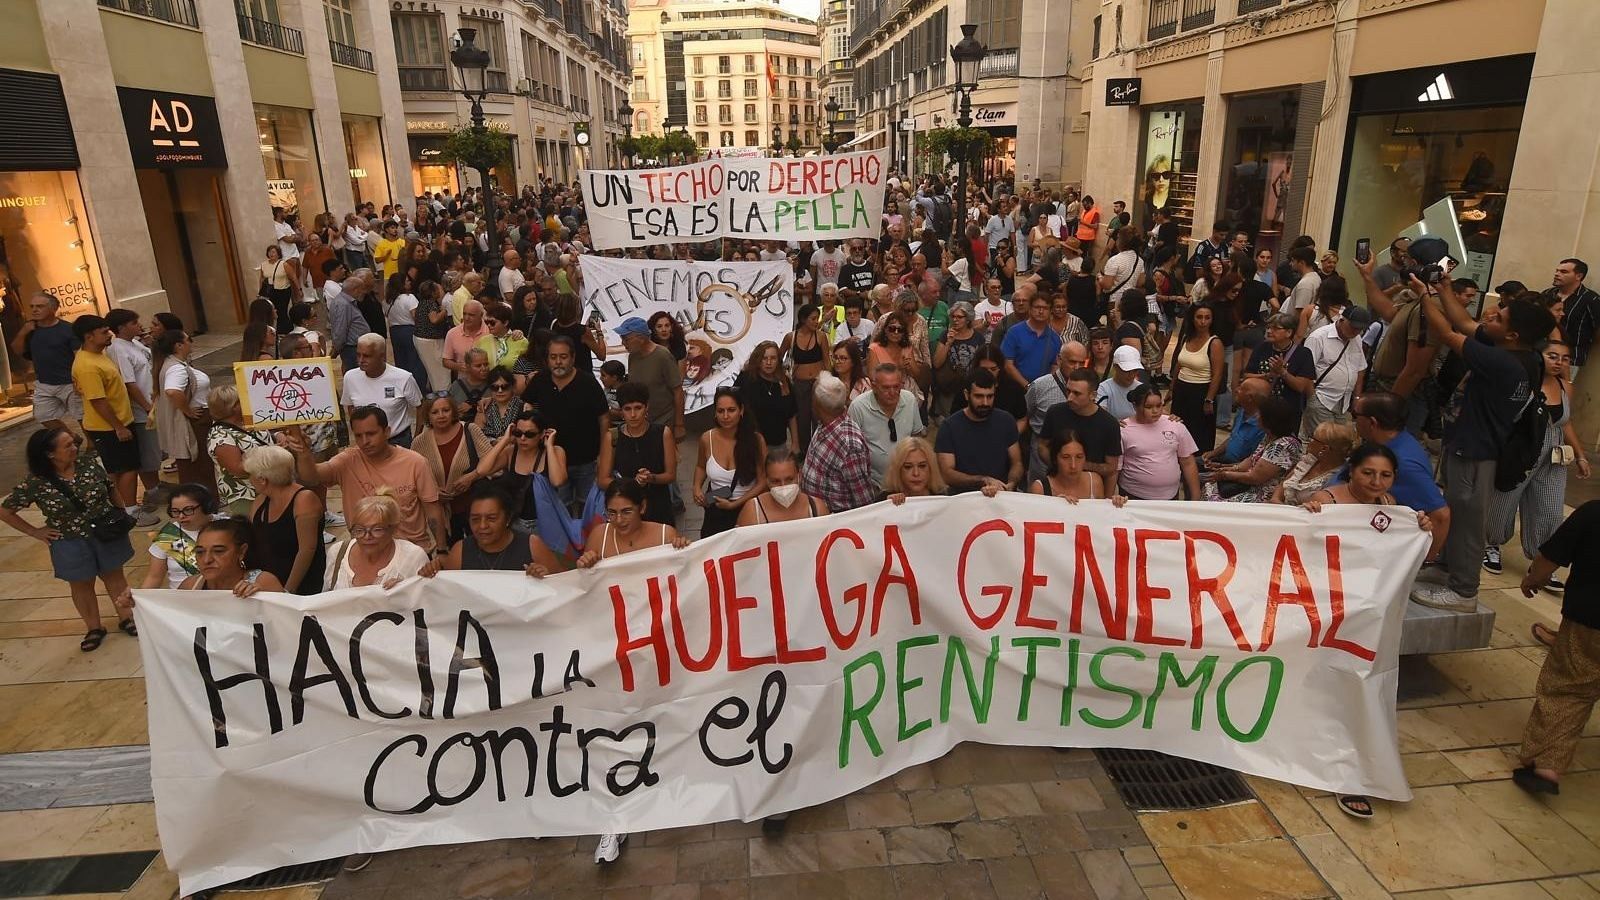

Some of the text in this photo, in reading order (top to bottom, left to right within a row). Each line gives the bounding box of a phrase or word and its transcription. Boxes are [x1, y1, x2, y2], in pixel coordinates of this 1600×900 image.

[392, 1, 441, 12] OTEL
[1110, 83, 1138, 99] Ray-Ban
[150, 98, 193, 133] AD
[975, 108, 1006, 120] Etam
[280, 182, 295, 190] LOLA
[590, 154, 881, 207] UN TECHO POR DERECHO
[0, 196, 46, 208] INGUEZ
[628, 188, 871, 241] ESA ES LA PELEA
[59, 293, 89, 309] ICES
[585, 267, 739, 322] TENEMOS
[671, 309, 733, 335] AVES
[251, 366, 325, 386] MÁLAGA
[296, 405, 334, 421] AMOS
[193, 519, 1377, 748] HACIA LA HUELGA GENERAL
[364, 635, 1284, 815] contra el RENTISMO
